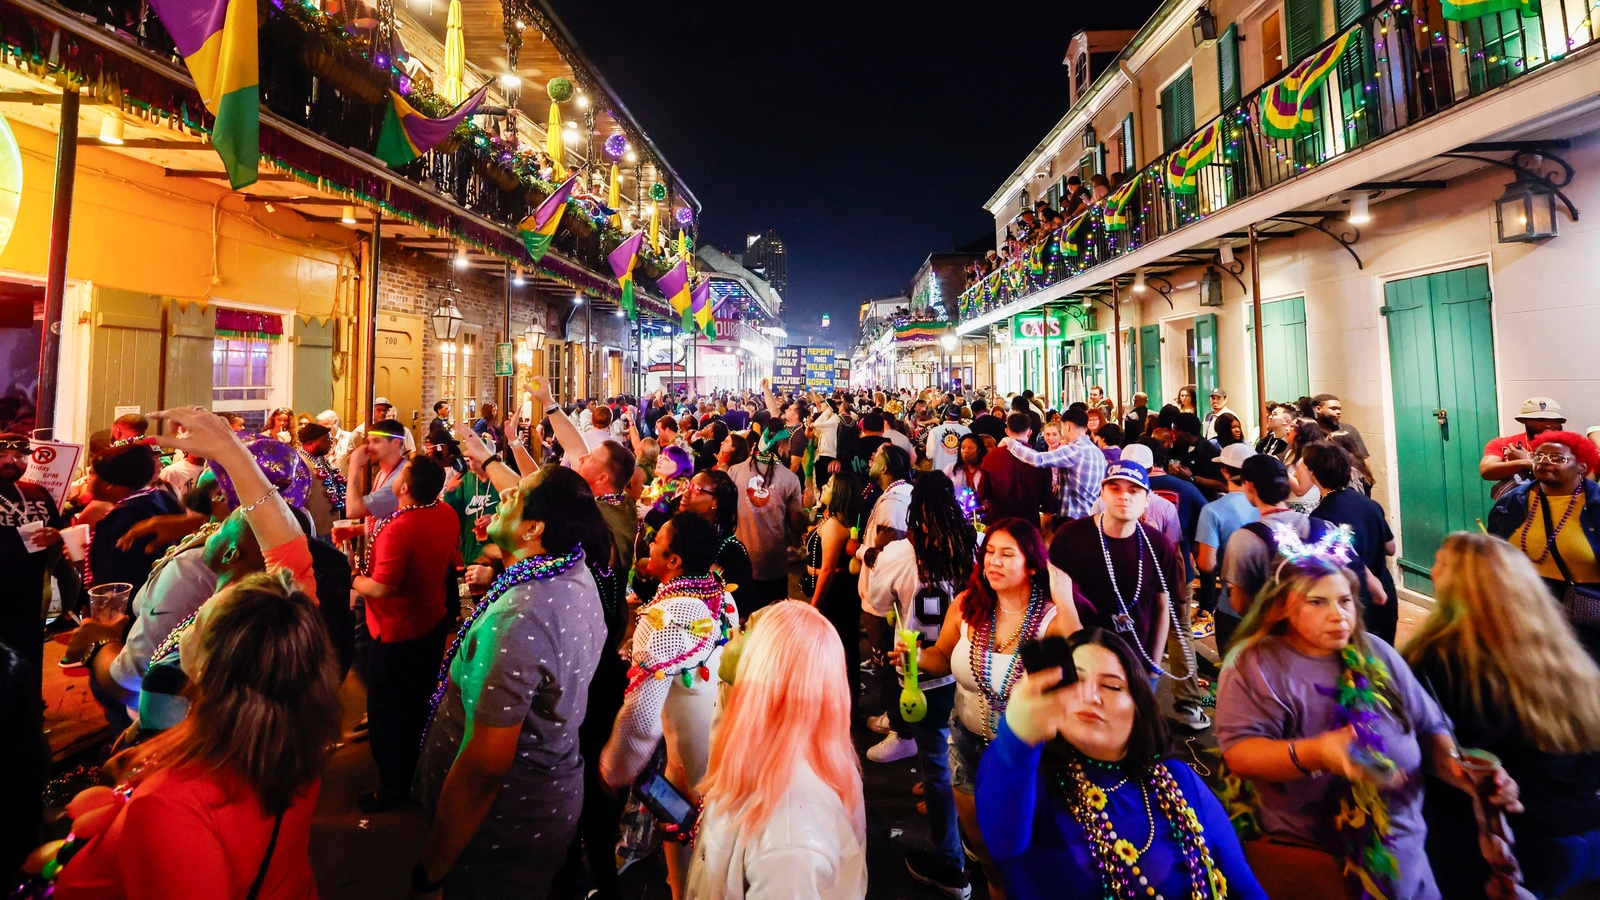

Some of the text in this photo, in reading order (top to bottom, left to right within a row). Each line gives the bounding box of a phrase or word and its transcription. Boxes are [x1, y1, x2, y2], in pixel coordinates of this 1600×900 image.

[384, 336, 398, 345] 700
[777, 348, 798, 357] LIVE
[807, 347, 834, 356] REPENT
[776, 358, 798, 367] HOLY
[806, 363, 833, 371] BELIEVE
[780, 367, 793, 376] OR
[772, 376, 800, 385] HELLFIRE
[806, 378, 833, 386] GOSPEL
[30, 464, 50, 472] Friday
[469, 494, 492, 506] NIKE
